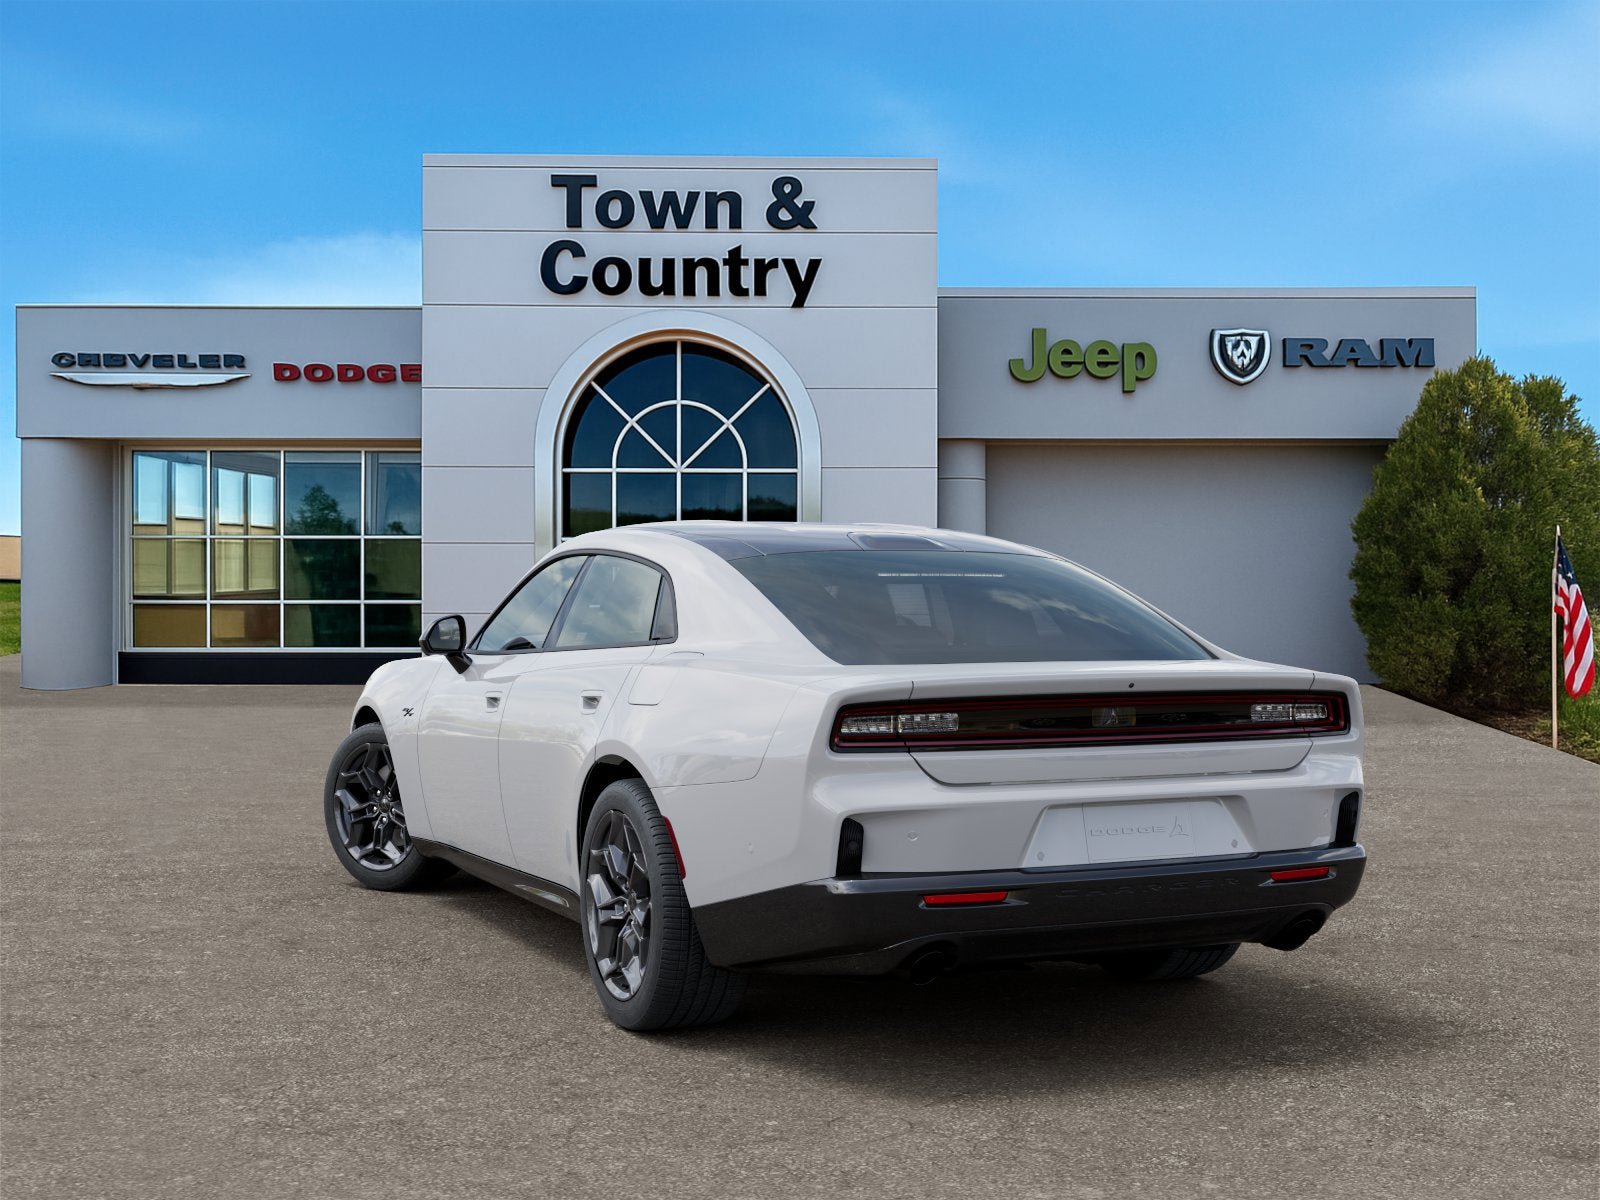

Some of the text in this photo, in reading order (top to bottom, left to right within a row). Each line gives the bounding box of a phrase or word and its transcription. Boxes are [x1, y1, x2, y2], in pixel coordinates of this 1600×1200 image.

[550, 174, 818, 230] Town &
[540, 239, 822, 308] Country
[273, 363, 422, 382] DODGE
[1009, 328, 1157, 393] Jeep
[1283, 338, 1435, 367] RAM
